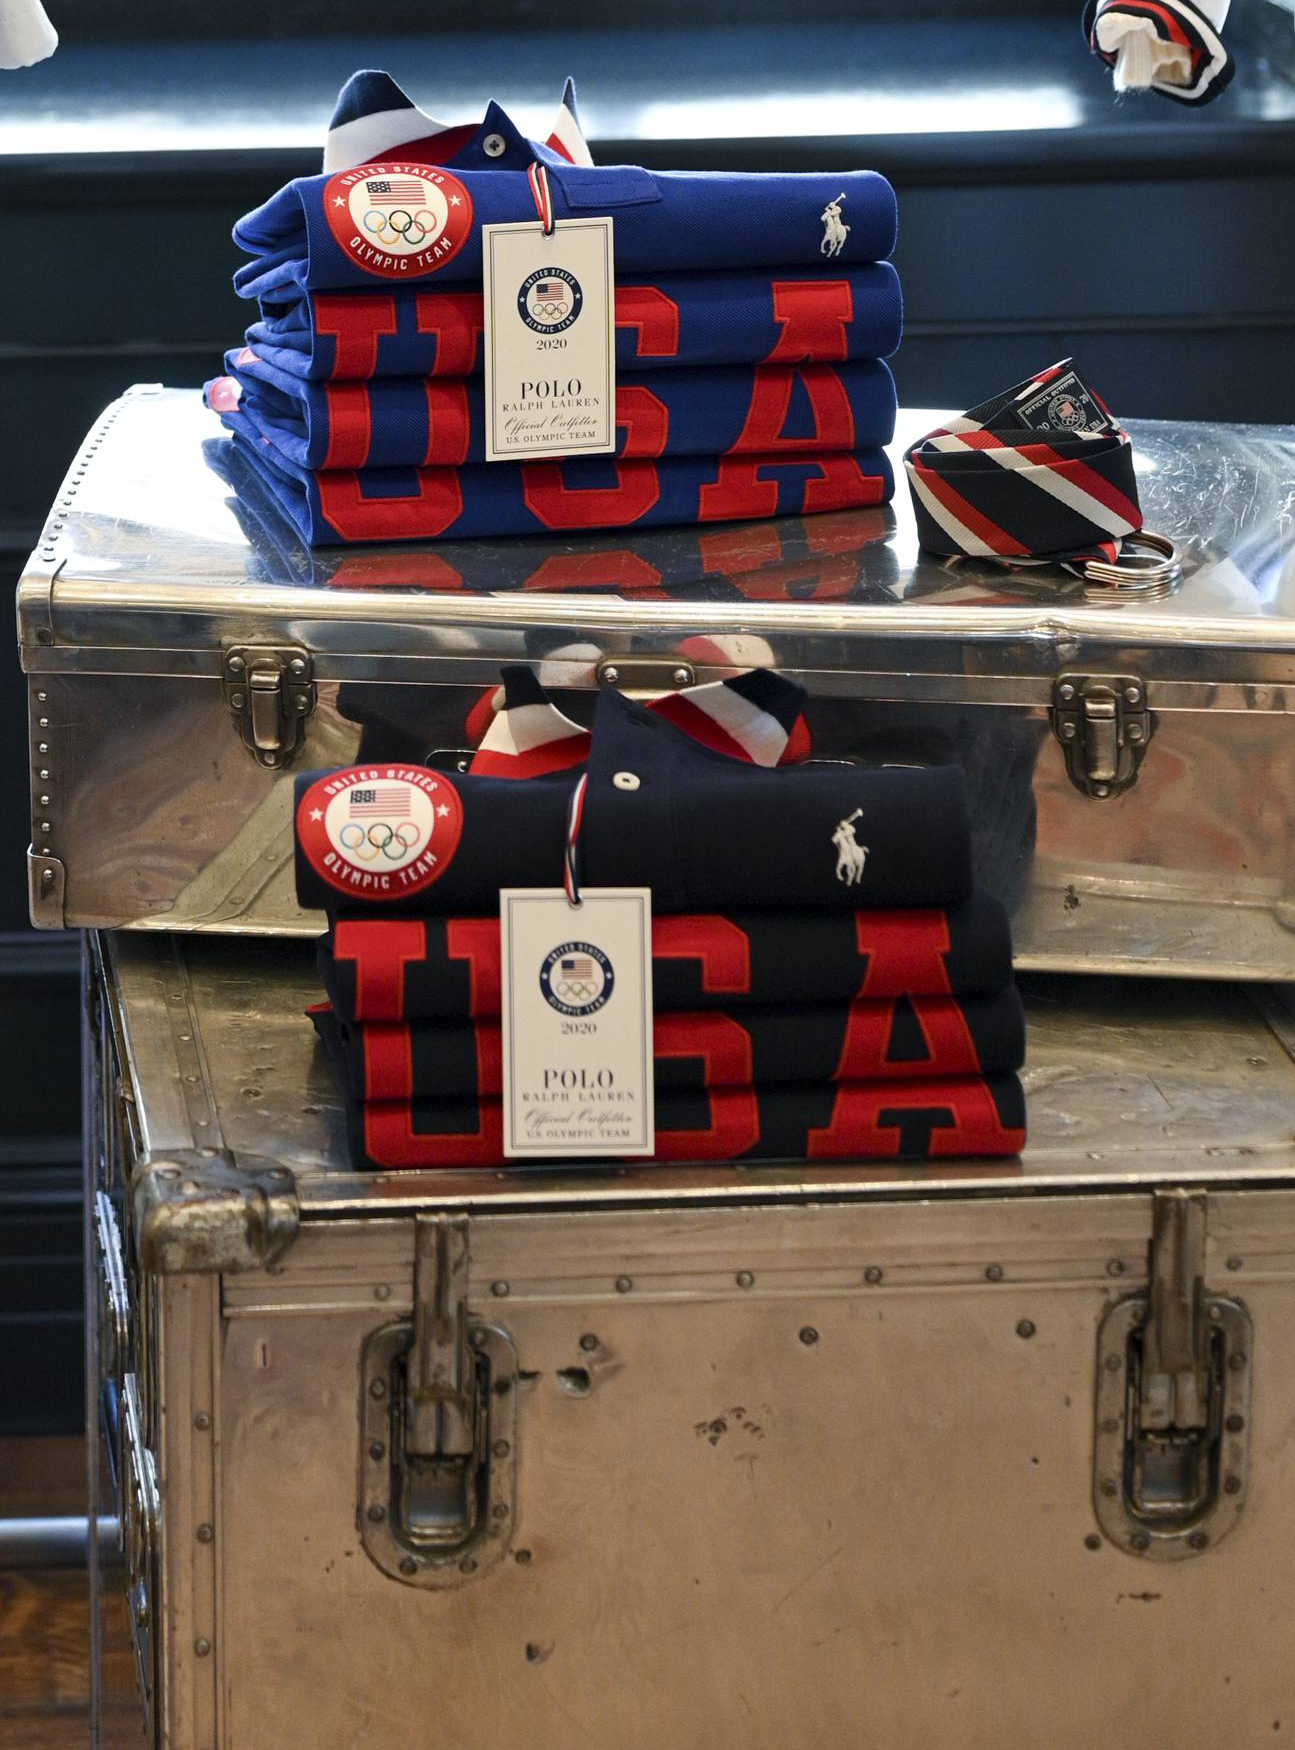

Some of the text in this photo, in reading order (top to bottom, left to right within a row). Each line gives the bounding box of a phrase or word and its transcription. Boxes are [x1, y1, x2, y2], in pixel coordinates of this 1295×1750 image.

[340, 166, 445, 186] UNITED STATES
[350, 236, 452, 270] OLYMPIC TEAM
[524, 269, 575, 288] UNITED STATES
[525, 315, 575, 332] OLYMPIC TEAM
[536, 338, 567, 350] 2020
[521, 378, 581, 399] POLO
[503, 397, 600, 412] RALPH LAUREN
[1025, 395, 1051, 415] OFFICIAL
[504, 413, 597, 435] Official Outfitter
[506, 431, 596, 444] U.S. OLYMPIC TEAM
[324, 769, 438, 796] UNITED STATES
[324, 850, 438, 889] OLYMPIC TEAM
[561, 1023, 597, 1035] 2020
[544, 1068, 613, 1090] POLO
[523, 1092, 634, 1102] RALPH LAUREN
[546, 1130, 595, 1138] OLYMPIC
[599, 1129, 630, 1137] TEAM
